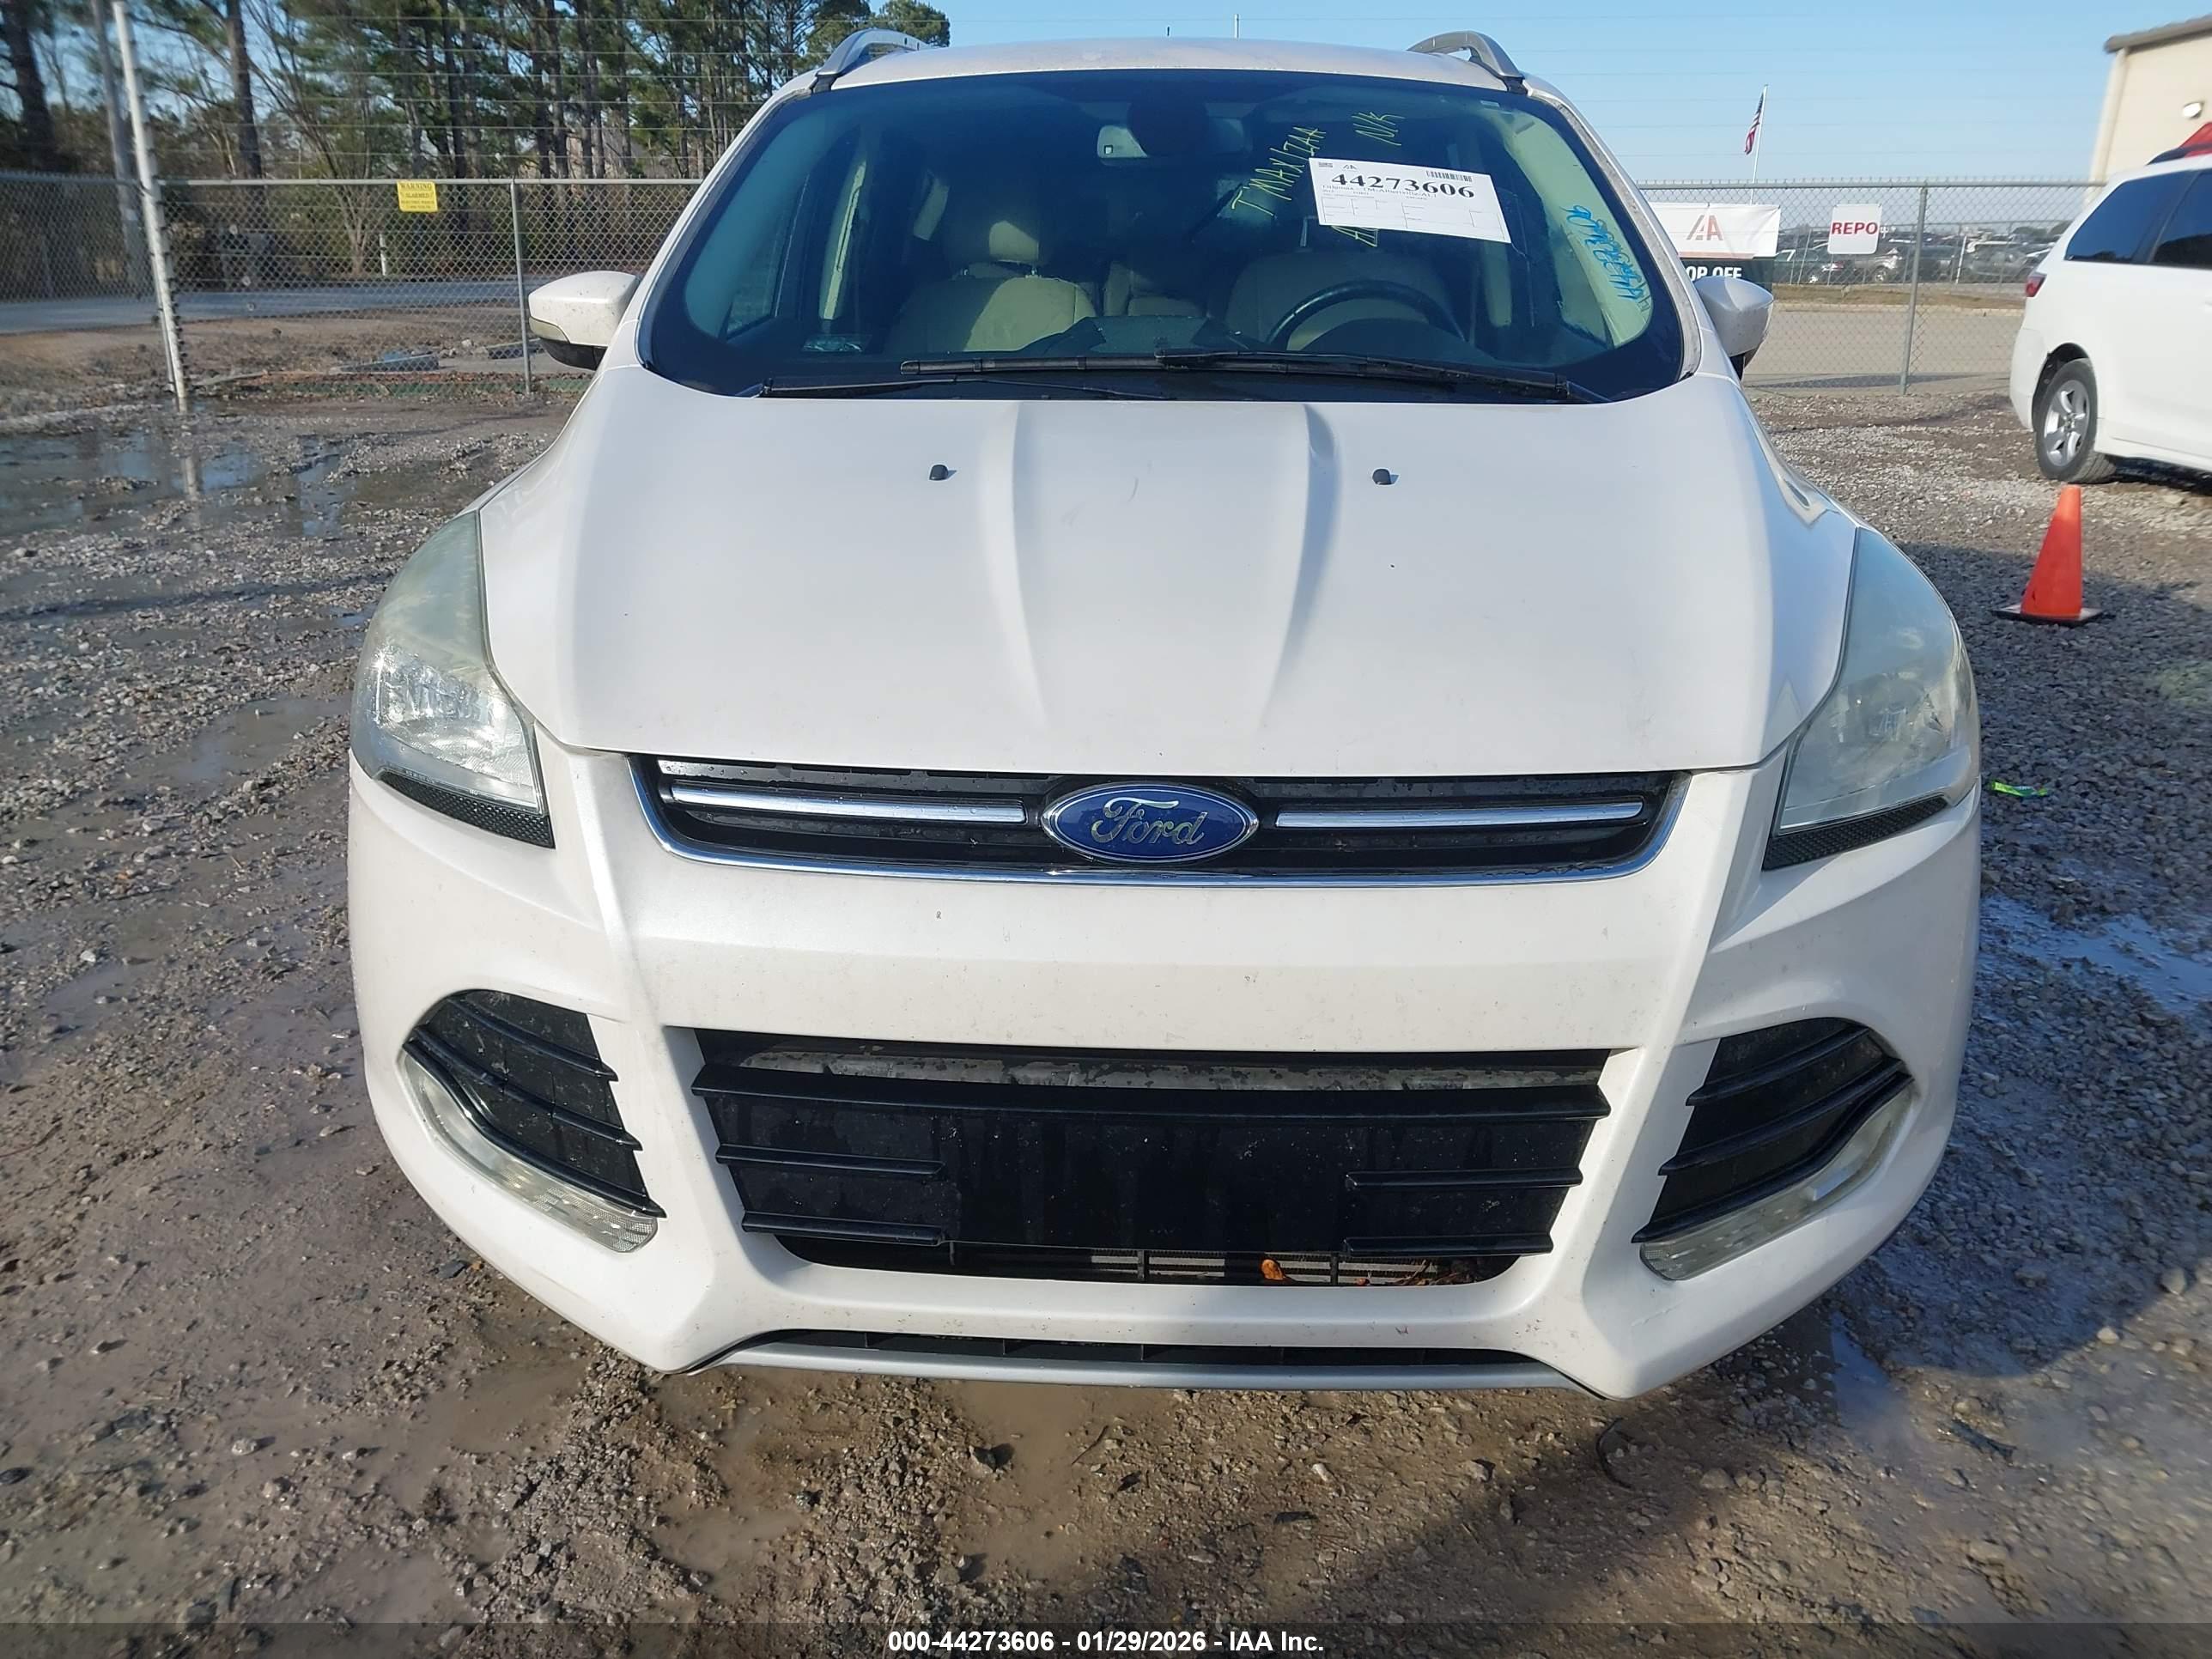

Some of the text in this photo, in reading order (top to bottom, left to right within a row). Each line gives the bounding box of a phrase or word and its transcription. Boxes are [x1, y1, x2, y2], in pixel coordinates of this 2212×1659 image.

[1331, 173, 1474, 198] 44273606
[1831, 222, 1879, 235] REPO
[1712, 266, 1742, 278] OFF
[1091, 797, 1208, 845] Ford
